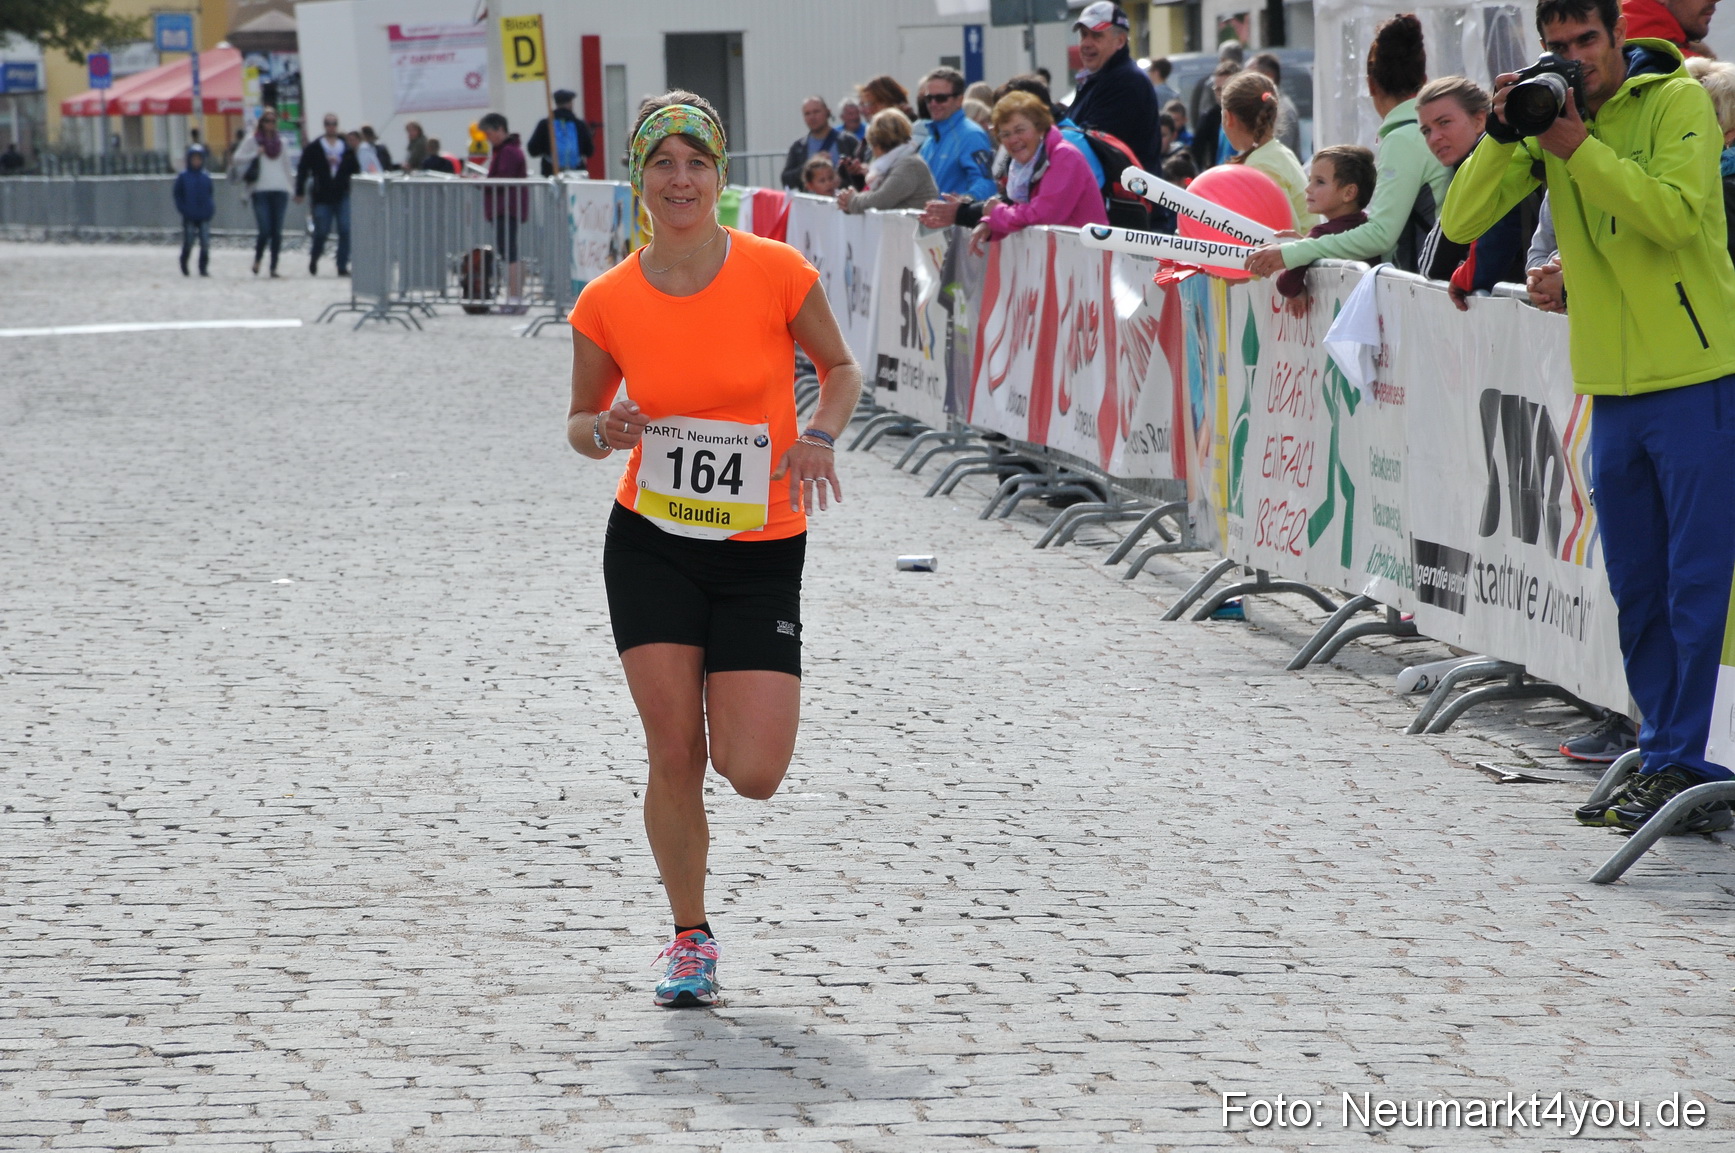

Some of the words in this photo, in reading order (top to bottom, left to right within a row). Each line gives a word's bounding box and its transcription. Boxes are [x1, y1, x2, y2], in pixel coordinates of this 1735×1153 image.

[505, 18, 539, 31] Block
[513, 35, 537, 67] D
[644, 425, 684, 440] PARTL
[687, 430, 748, 445] Neumarkt
[666, 446, 743, 495] 164
[668, 501, 731, 525] Claudia
